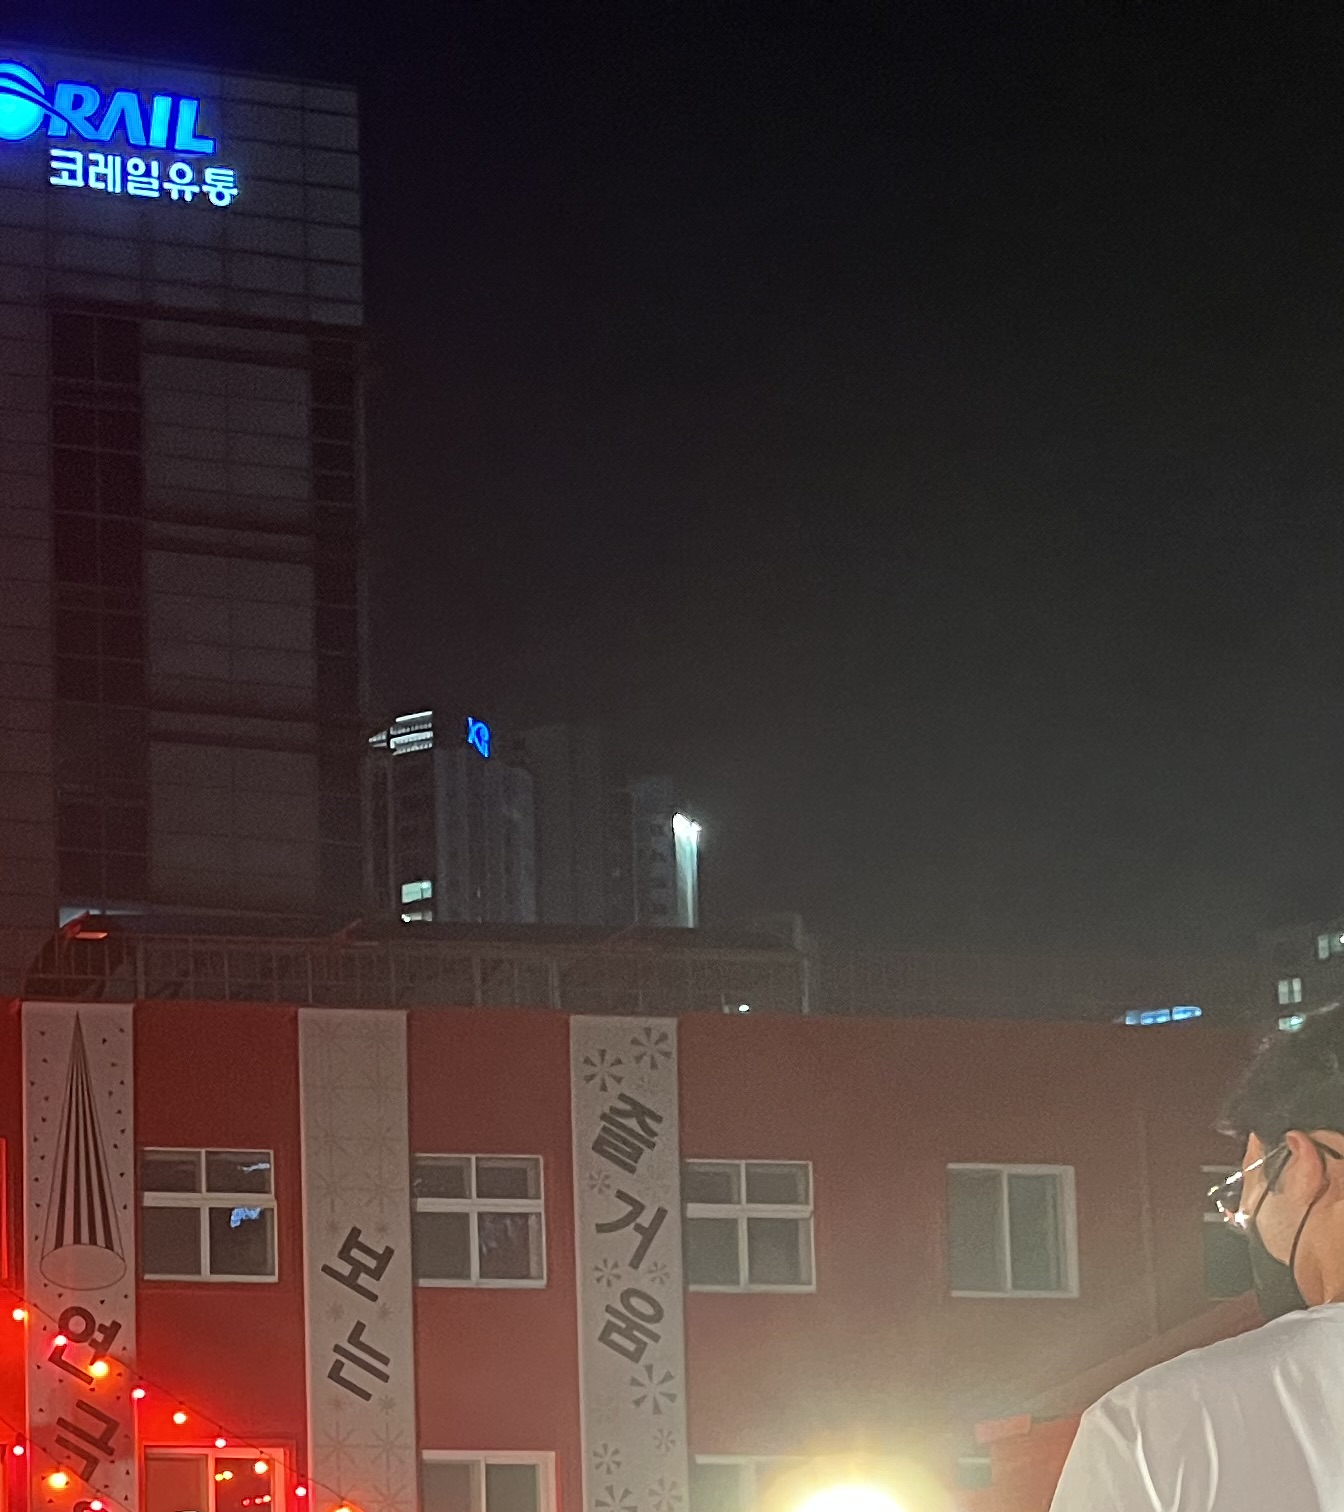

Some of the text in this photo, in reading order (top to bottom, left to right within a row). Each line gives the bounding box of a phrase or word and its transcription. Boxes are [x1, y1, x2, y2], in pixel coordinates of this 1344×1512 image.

[49, 147, 238, 207] 코레일유통
[320, 1225, 396, 1402] 보는
[591, 1092, 669, 1364] 즐거움
